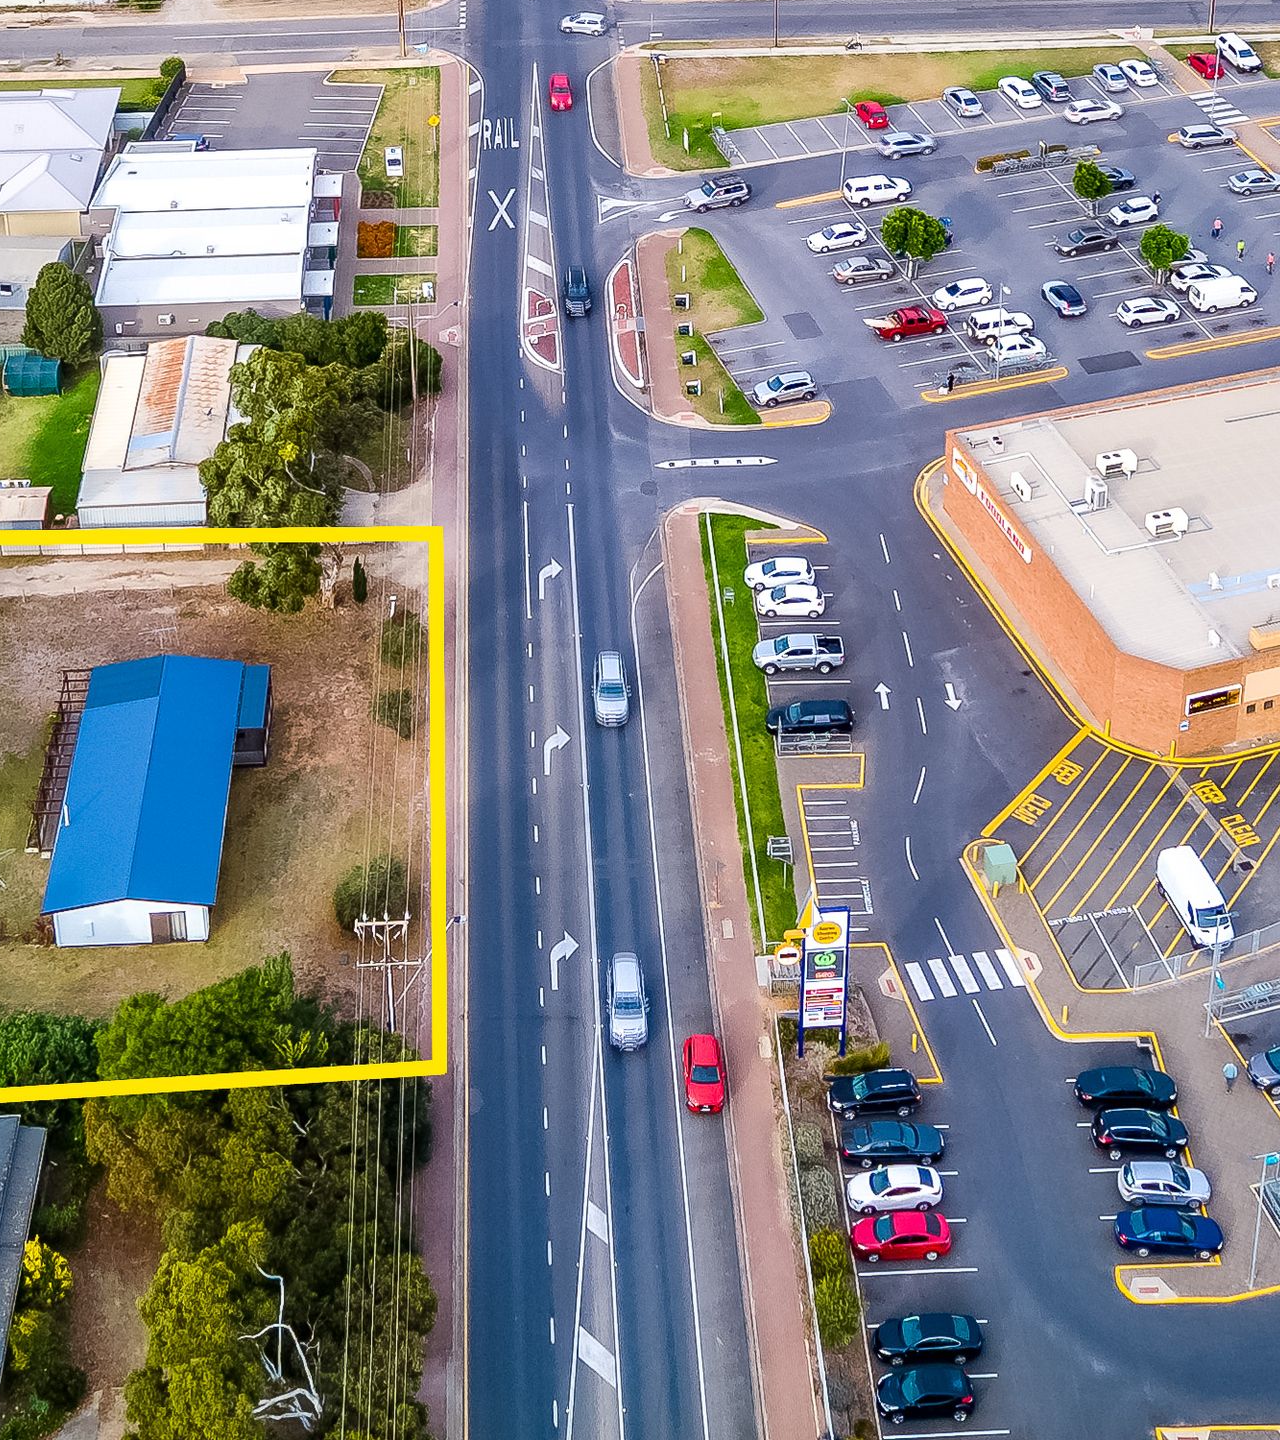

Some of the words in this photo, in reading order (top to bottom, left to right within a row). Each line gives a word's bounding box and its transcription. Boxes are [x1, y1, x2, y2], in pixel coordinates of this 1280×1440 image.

[483, 118, 520, 150] RAIL
[981, 490, 1025, 555] FOODLAND
[1011, 794, 1053, 826] CLEAR
[1190, 779, 1227, 804] KEEP
[1219, 813, 1261, 848] CLEAR
